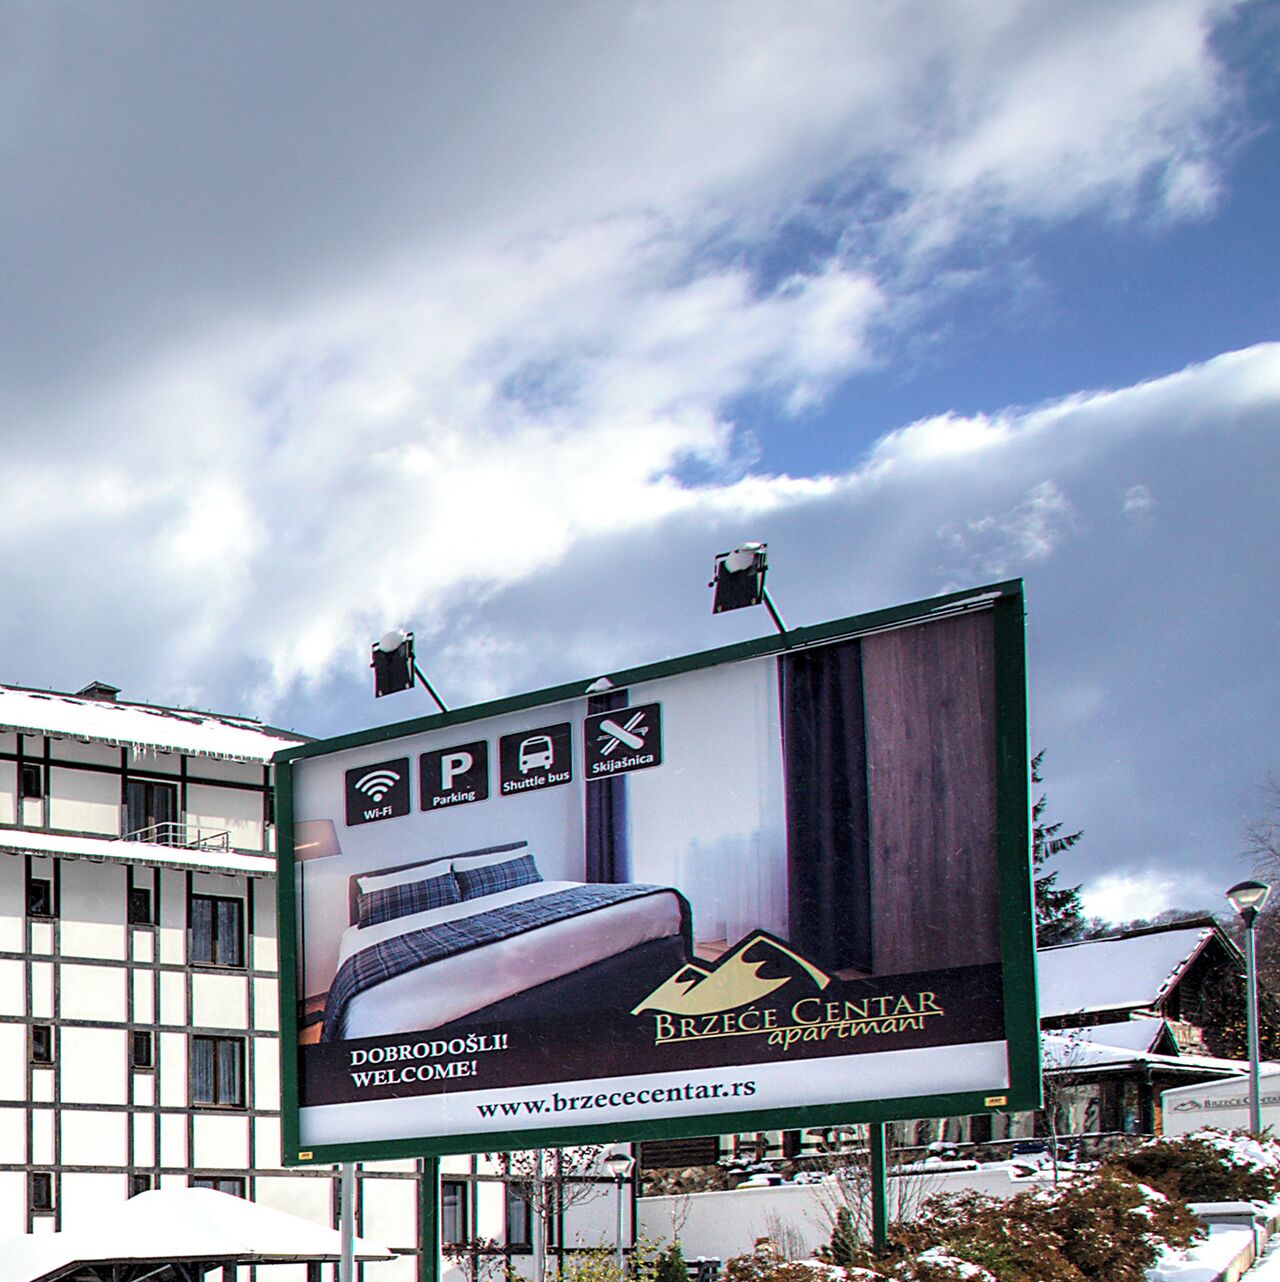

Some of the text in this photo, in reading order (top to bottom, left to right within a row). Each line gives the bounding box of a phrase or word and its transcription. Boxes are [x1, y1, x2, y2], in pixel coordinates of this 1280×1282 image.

[441, 752, 474, 791] P
[592, 754, 654, 774] Skijašnica
[502, 771, 571, 792] Shuttle bus
[363, 805, 393, 820] Wi-Fi
[433, 790, 476, 806] Parking
[791, 991, 941, 1025] CENTAR
[767, 1015, 926, 1050] apartmani
[350, 1033, 509, 1066] DOBRODOŠLI!
[350, 1060, 478, 1087] WELCOME!
[476, 1080, 757, 1118] www.brzececentar.rs
